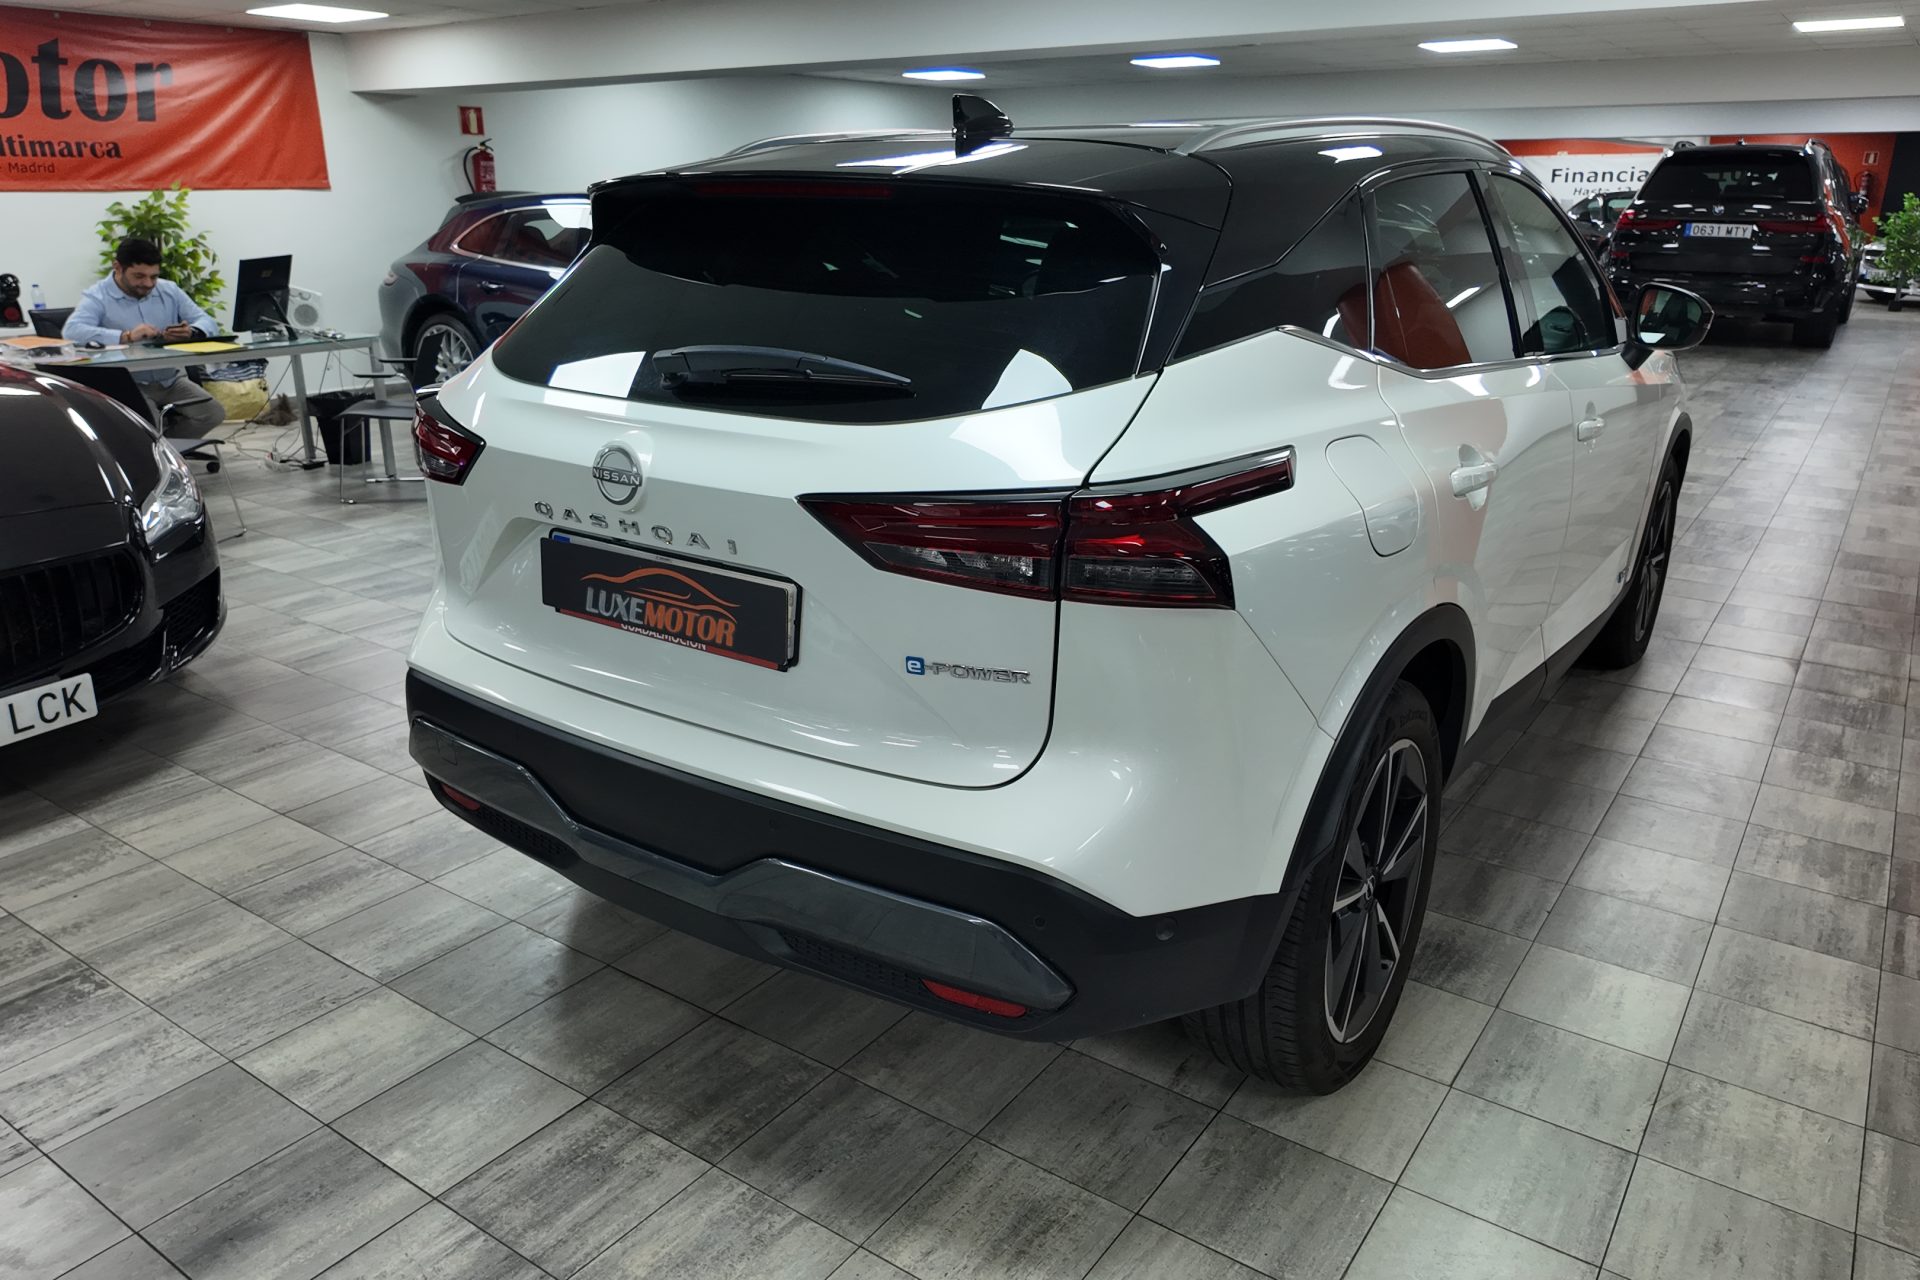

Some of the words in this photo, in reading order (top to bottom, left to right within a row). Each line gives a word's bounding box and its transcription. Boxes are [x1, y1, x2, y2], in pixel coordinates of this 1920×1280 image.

[8, 162, 55, 174] Madrid
[1551, 166, 1651, 183] Financia
[1692, 224, 1721, 235] 0631
[1726, 226, 1748, 237] MTY
[593, 467, 640, 485] NISSAN
[534, 501, 738, 555] QASHQAI
[585, 586, 736, 647] LUXEMOTOR
[8, 682, 87, 734] LCK
